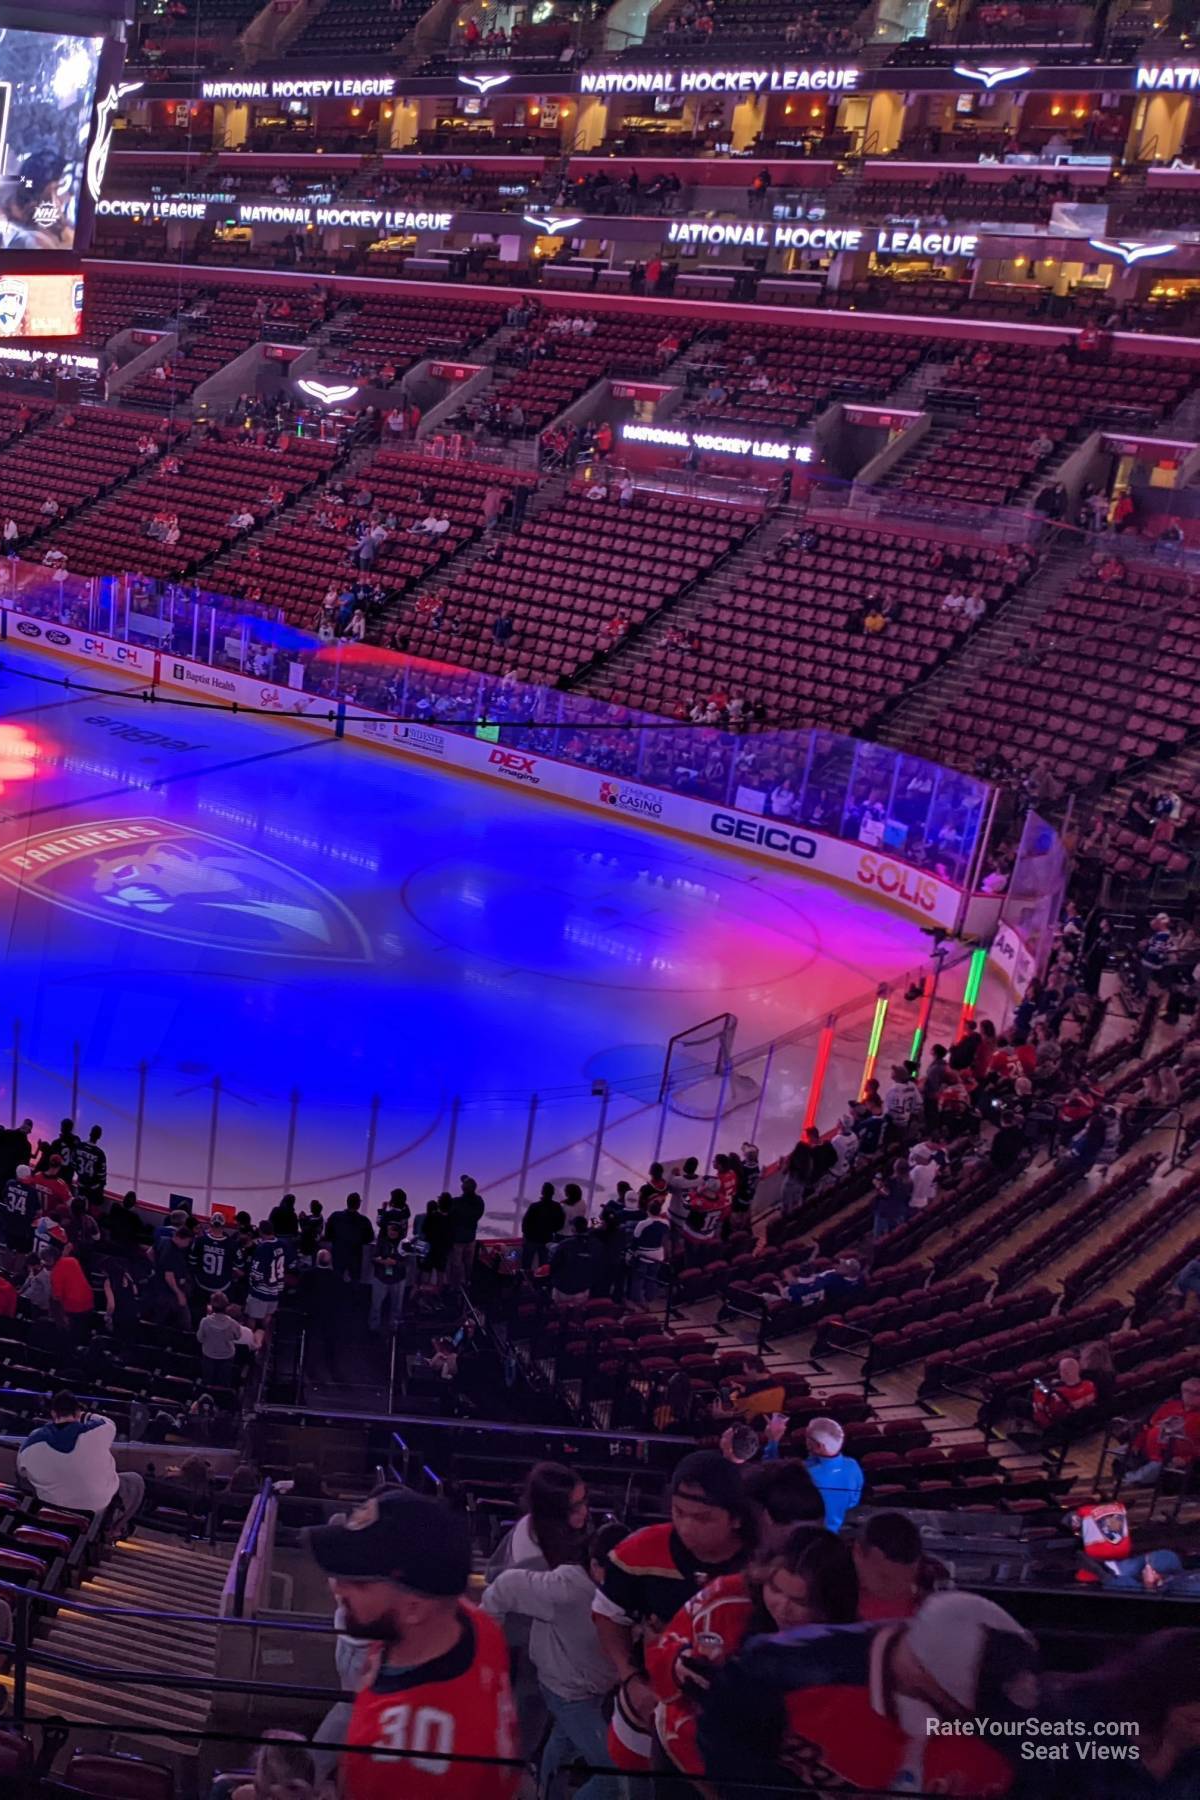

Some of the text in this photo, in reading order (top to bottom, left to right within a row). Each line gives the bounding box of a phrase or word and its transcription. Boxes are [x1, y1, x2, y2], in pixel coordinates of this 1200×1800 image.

[203, 79, 395, 98] NATIONAL HOCKEY LEAGUE
[581, 70, 859, 92] NATIONAL HOCKEY LEAGUE
[1136, 68, 1200, 89] NATI
[33, 206, 61, 219] NHL
[153, 203, 206, 219] LEAGUE
[240, 207, 453, 231] NATIONAL HOCKEY LEAGUE
[877, 233, 979, 257] LEAGUE
[623, 424, 690, 447] NATIONAL
[185, 669, 236, 692] Baptist Health
[488, 749, 538, 774] DEX
[497, 766, 540, 785] imaging
[618, 793, 663, 815] CASINO
[10, 823, 162, 871] PANTHERS
[710, 813, 817, 860] GEICO
[857, 855, 939, 911] SOLIS
[7, 1191, 27, 1216] 34
[202, 1253, 224, 1276] 91
[377, 1704, 456, 1775] 30
